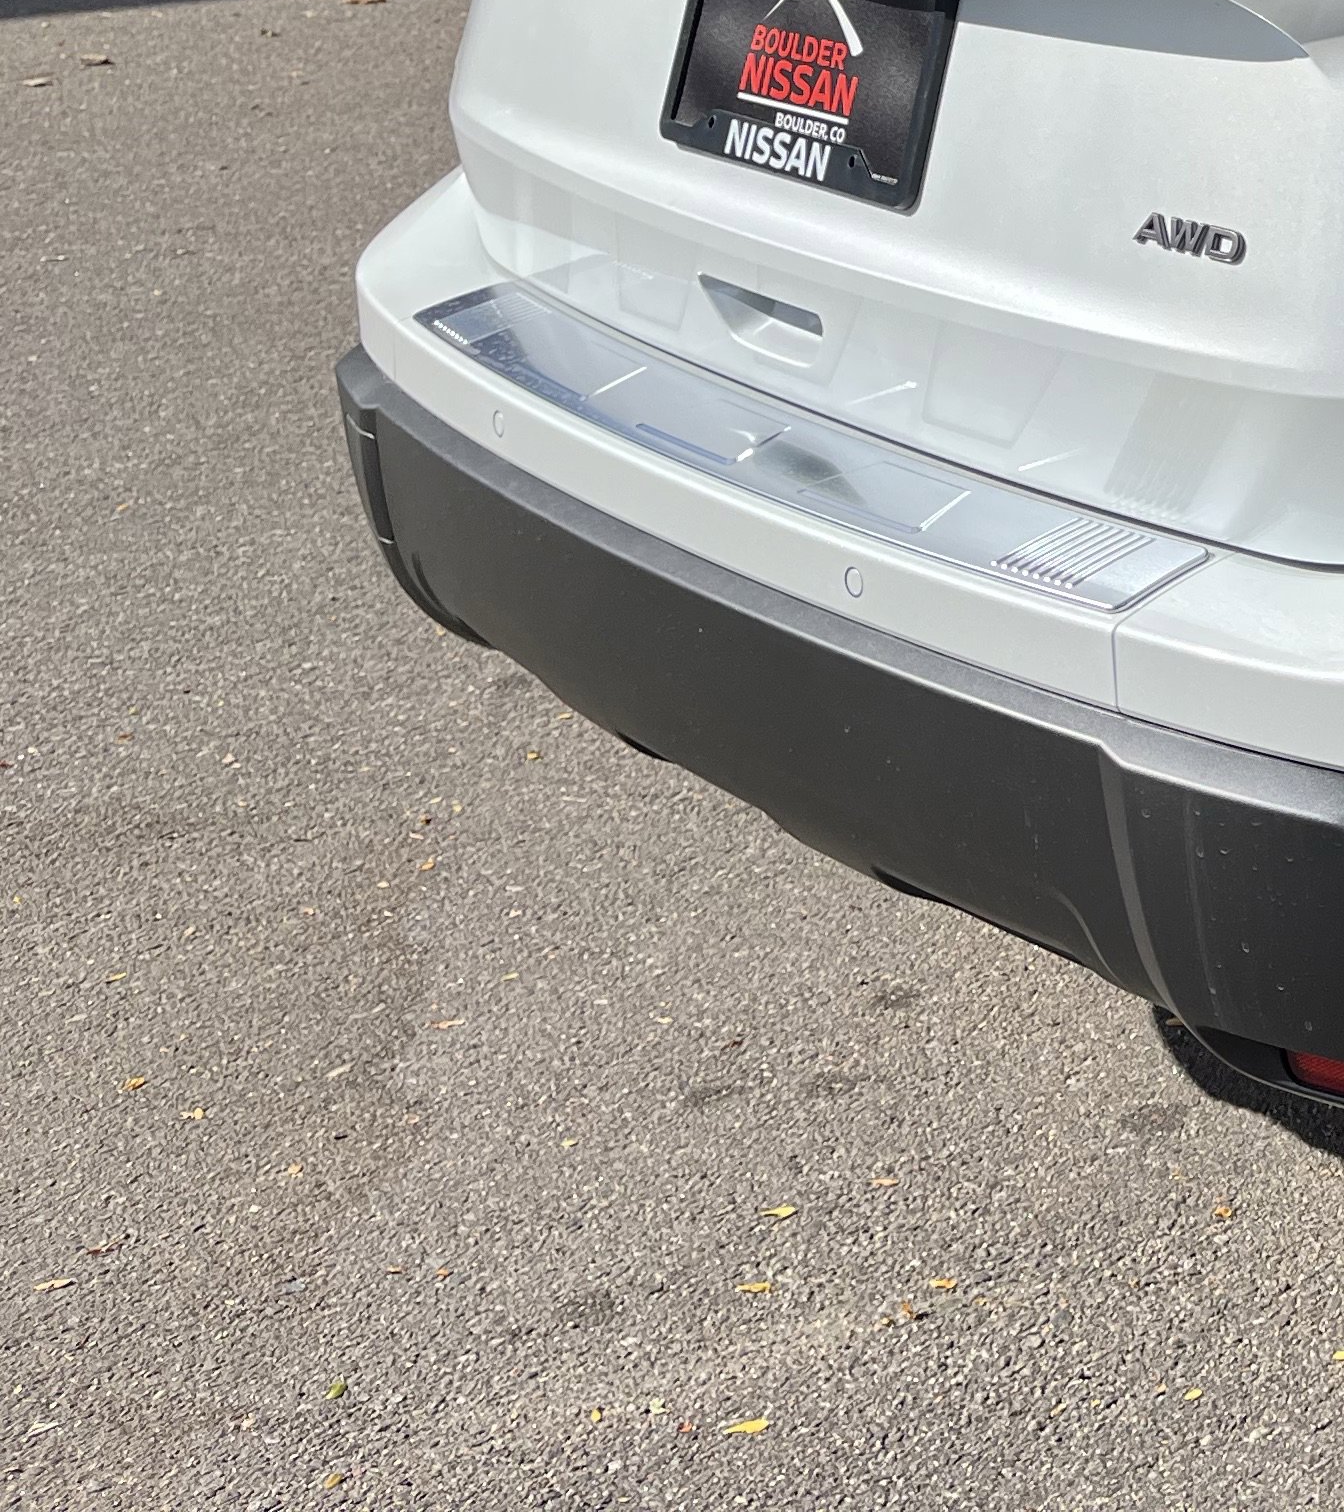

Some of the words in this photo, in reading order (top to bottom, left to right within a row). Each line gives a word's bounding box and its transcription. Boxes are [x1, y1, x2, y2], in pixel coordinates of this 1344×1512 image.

[750, 23, 849, 71] BOULDER
[738, 52, 859, 117] NISSAN
[723, 117, 832, 182] NISSAN
[829, 125, 847, 144] CO
[1132, 212, 1248, 266] AWD
